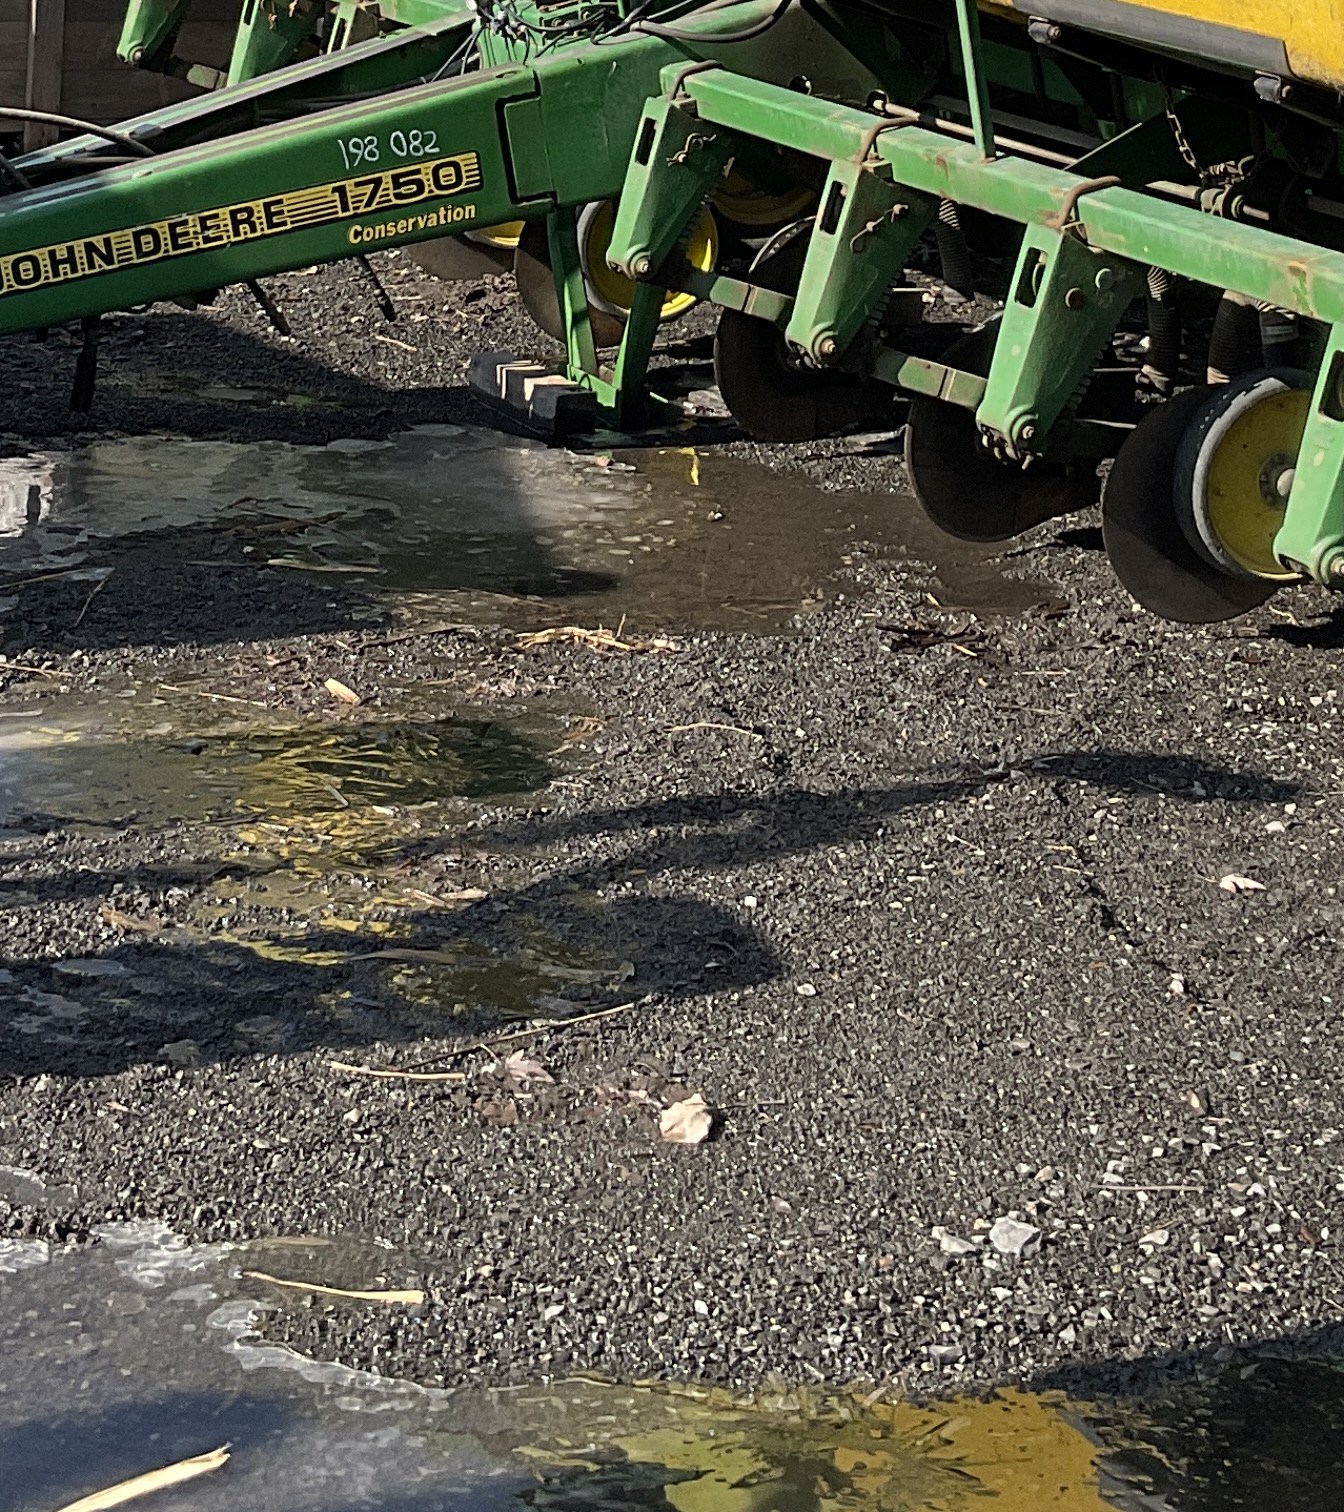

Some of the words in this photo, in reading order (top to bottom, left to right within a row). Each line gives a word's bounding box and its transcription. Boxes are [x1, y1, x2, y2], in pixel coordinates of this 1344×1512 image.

[337, 135, 380, 170] 198
[389, 129, 441, 157] 082
[130, 198, 289, 260] DEERE
[330, 159, 464, 215] 1750
[347, 203, 477, 245] Conservation
